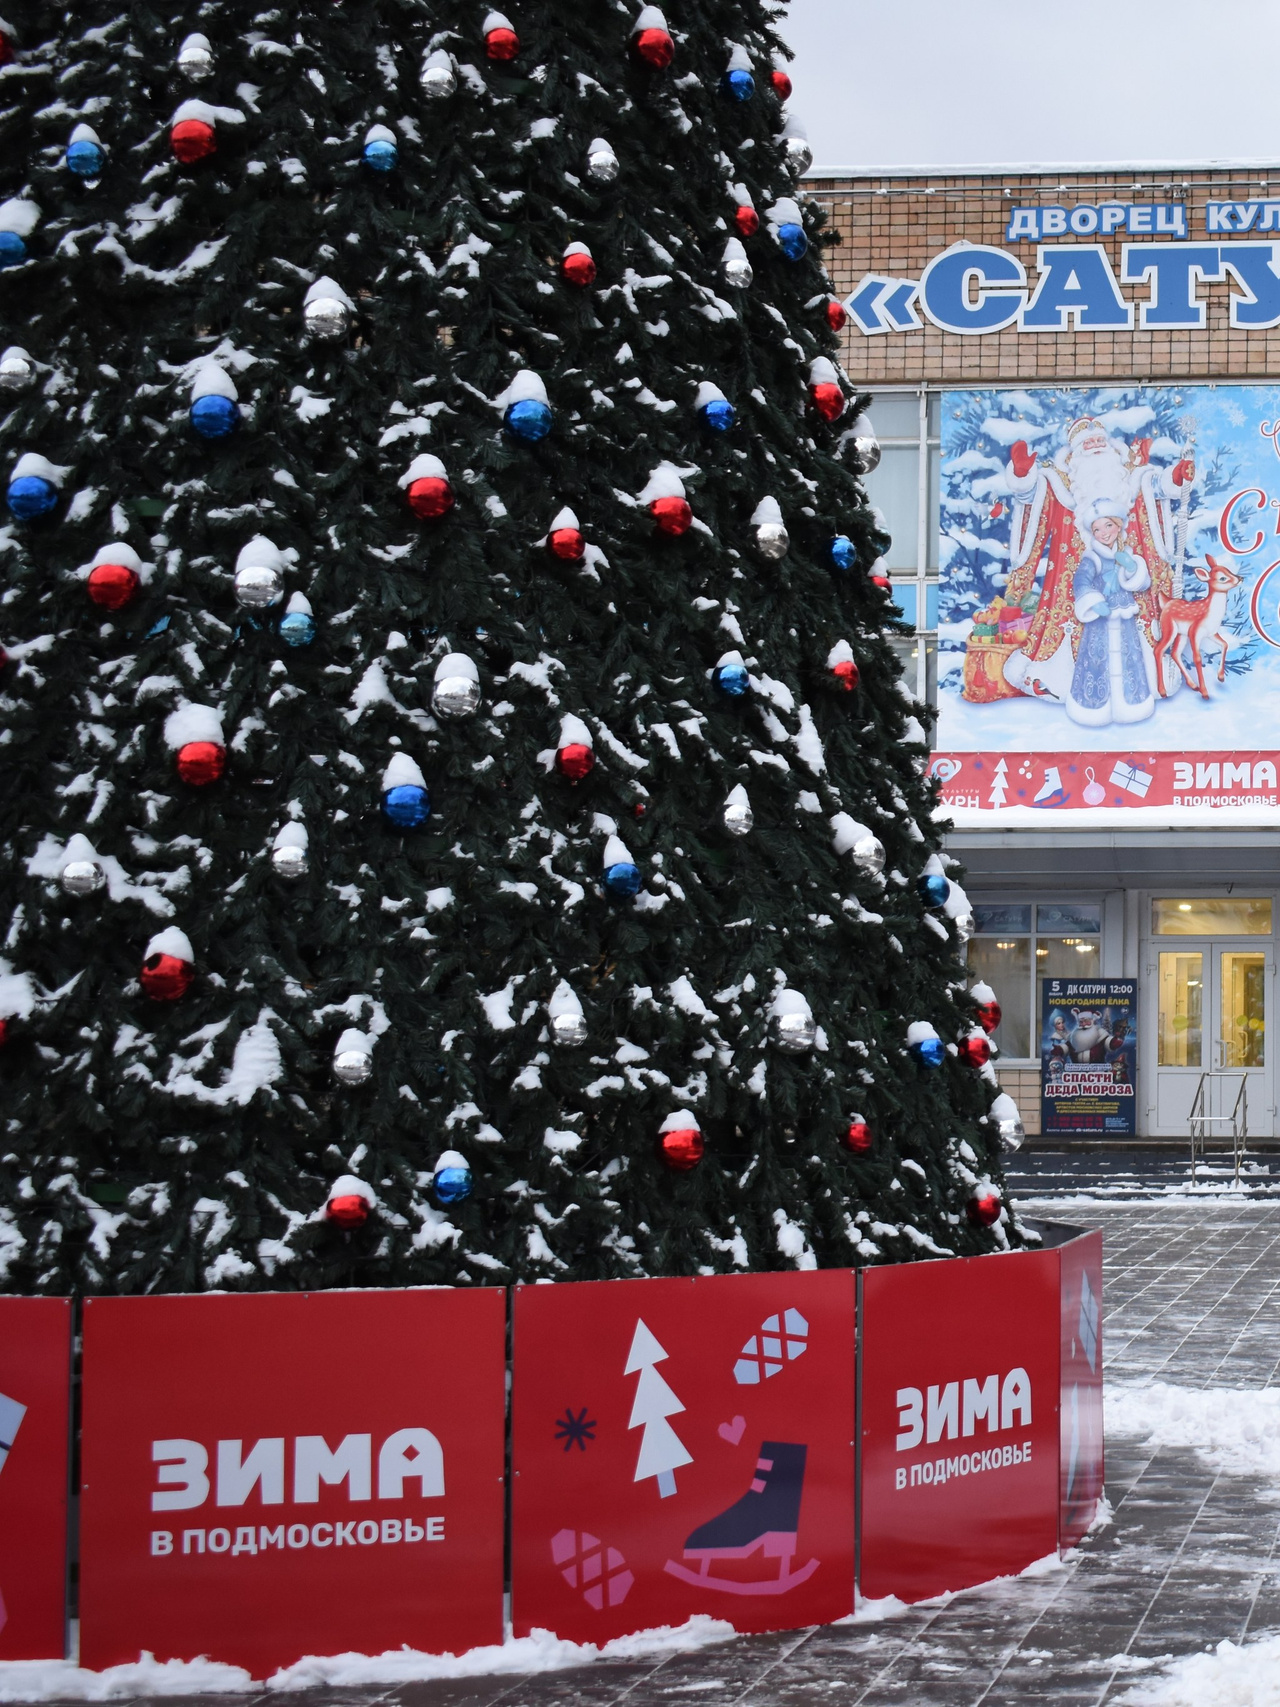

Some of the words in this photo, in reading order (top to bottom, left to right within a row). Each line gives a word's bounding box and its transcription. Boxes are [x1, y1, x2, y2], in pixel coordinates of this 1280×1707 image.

[1008, 204, 1187, 240] ДВОРЕЦ
[1220, 488, 1266, 554] С
[1173, 760, 1277, 789] ЗИМА
[1173, 796, 1181, 806] В
[1184, 795, 1277, 806] ПОДМОСКОВЬЕ
[1052, 980, 1060, 991] 5
[1067, 984, 1078, 995] ДК
[1078, 984, 1106, 994] САТУРН
[1110, 985, 1133, 994] 12:00
[1107, 996, 1130, 1005] ЁЛКА
[1046, 1085, 1079, 1096] ДЕДА
[1082, 1085, 1132, 1095] МОРОЗА
[1063, 1073, 1112, 1083] СПАСТИ
[896, 1367, 1032, 1452] ЗИМА
[151, 1427, 446, 1512] ЗИМА
[896, 1467, 907, 1490] В
[910, 1441, 1032, 1487] ПОДМОСКОВЬЕ
[151, 1530, 174, 1556] В
[183, 1516, 446, 1556] ПОДМОСКОВЬЕ
